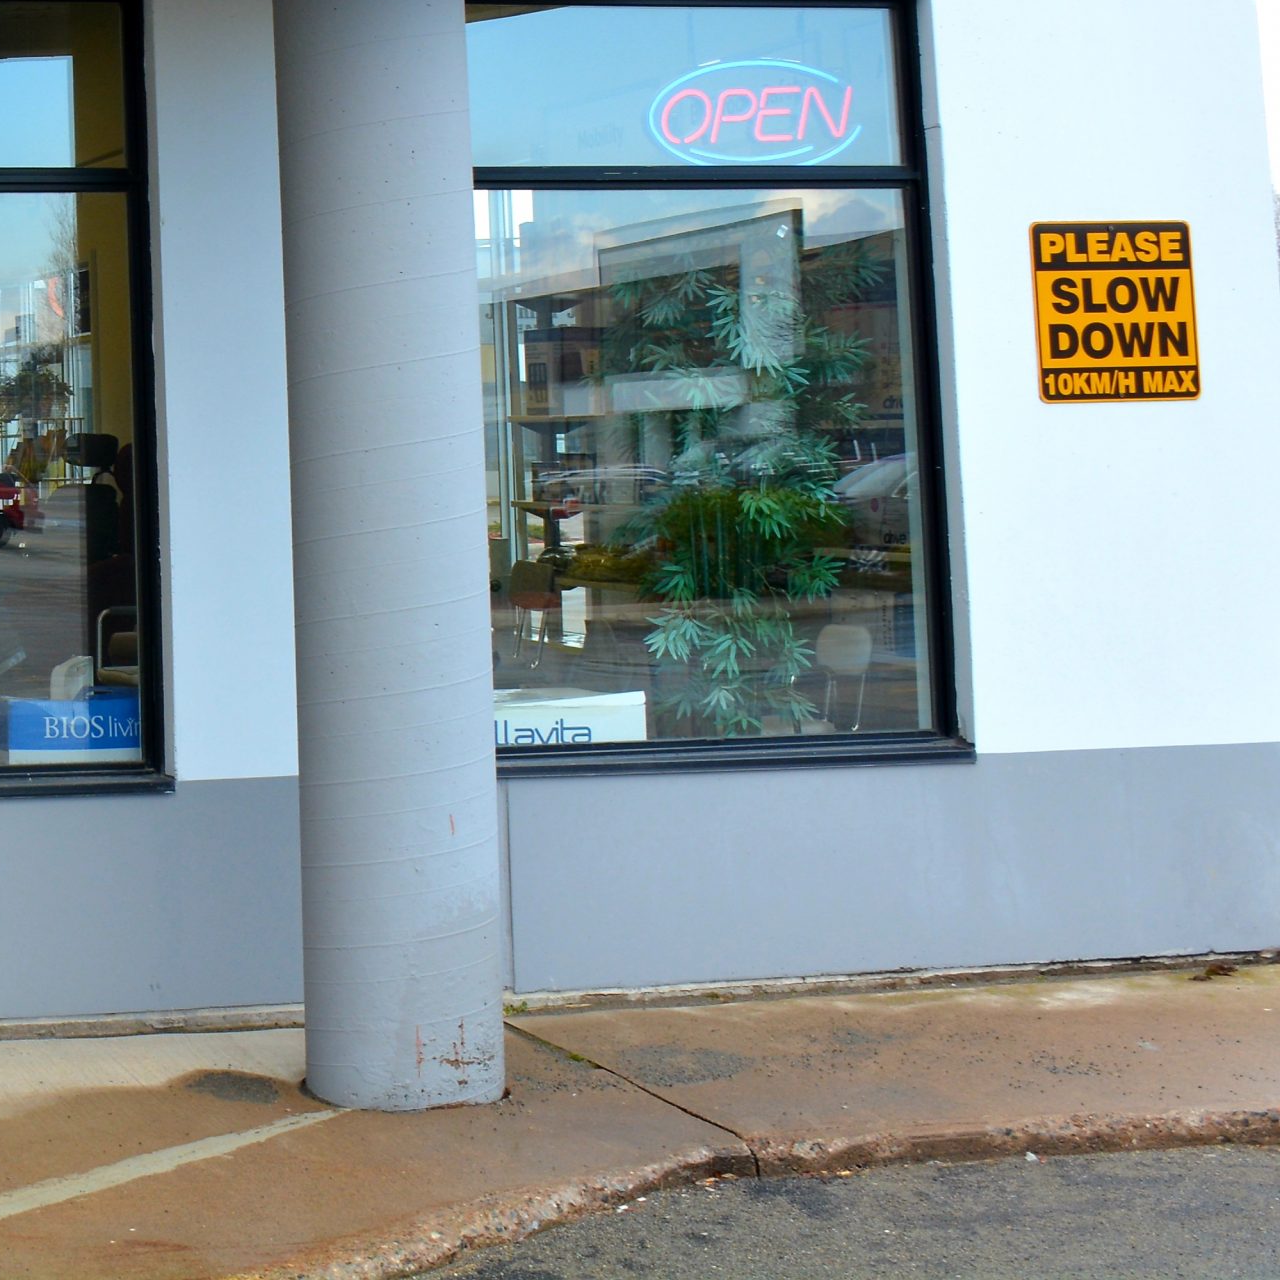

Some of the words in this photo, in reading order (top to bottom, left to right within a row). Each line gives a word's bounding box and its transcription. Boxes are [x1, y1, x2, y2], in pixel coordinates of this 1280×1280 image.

[660, 85, 855, 144] OPEN
[1039, 231, 1184, 263] PLEASE
[1051, 276, 1180, 315] SLOW
[1048, 321, 1189, 360] DOWN
[1045, 370, 1136, 395] 10KM/H
[1142, 370, 1197, 394] MAX
[42, 715, 105, 739] BIOS
